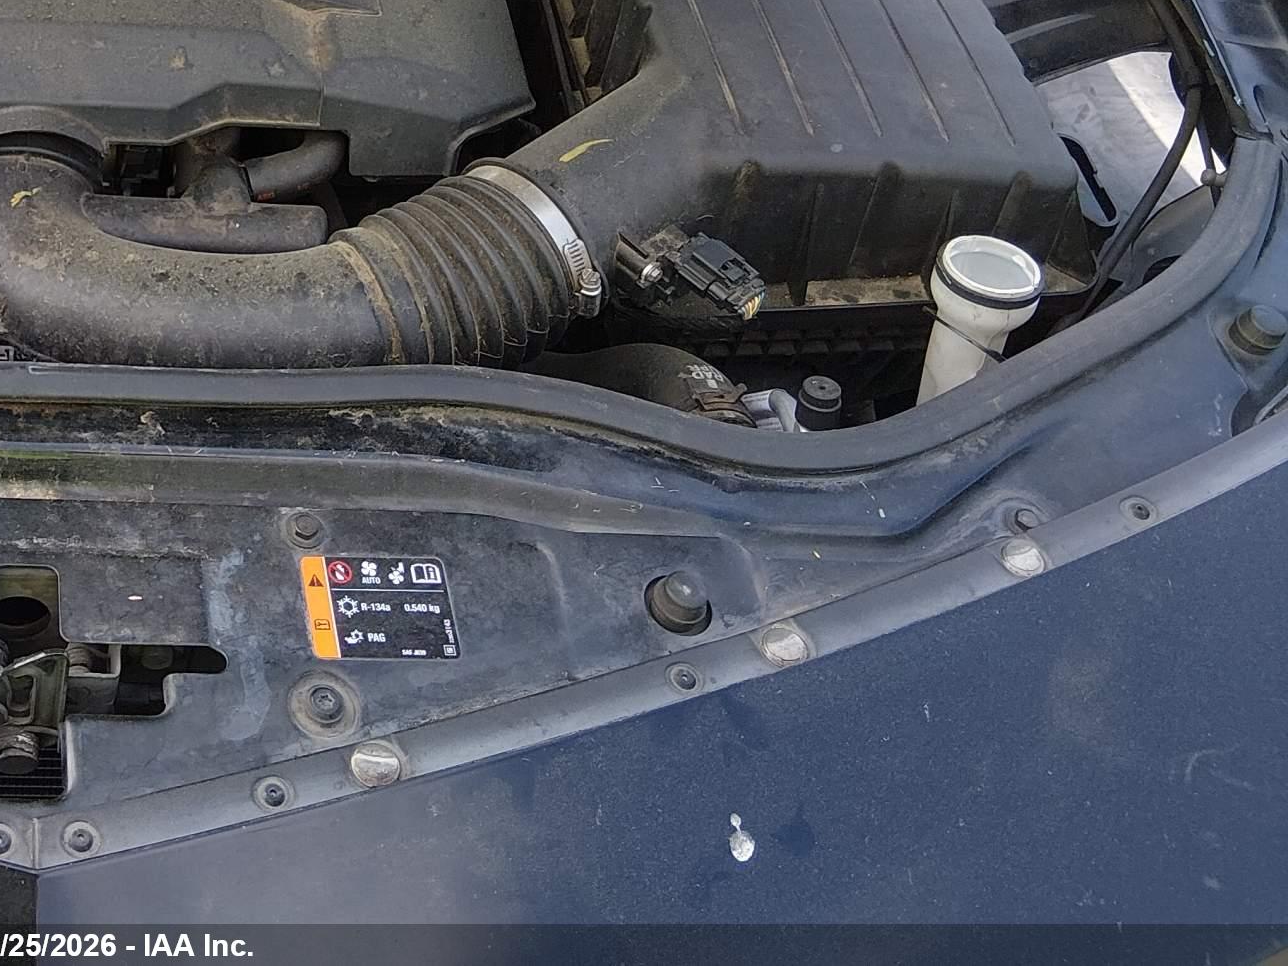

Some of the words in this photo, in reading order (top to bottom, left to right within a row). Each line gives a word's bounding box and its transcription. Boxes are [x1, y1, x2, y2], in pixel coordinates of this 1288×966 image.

[362, 577, 381, 585] AUTO
[361, 603, 391, 612] R-134a
[404, 603, 428, 612] 0.540
[429, 604, 441, 614] kg
[368, 633, 386, 643] PAG
